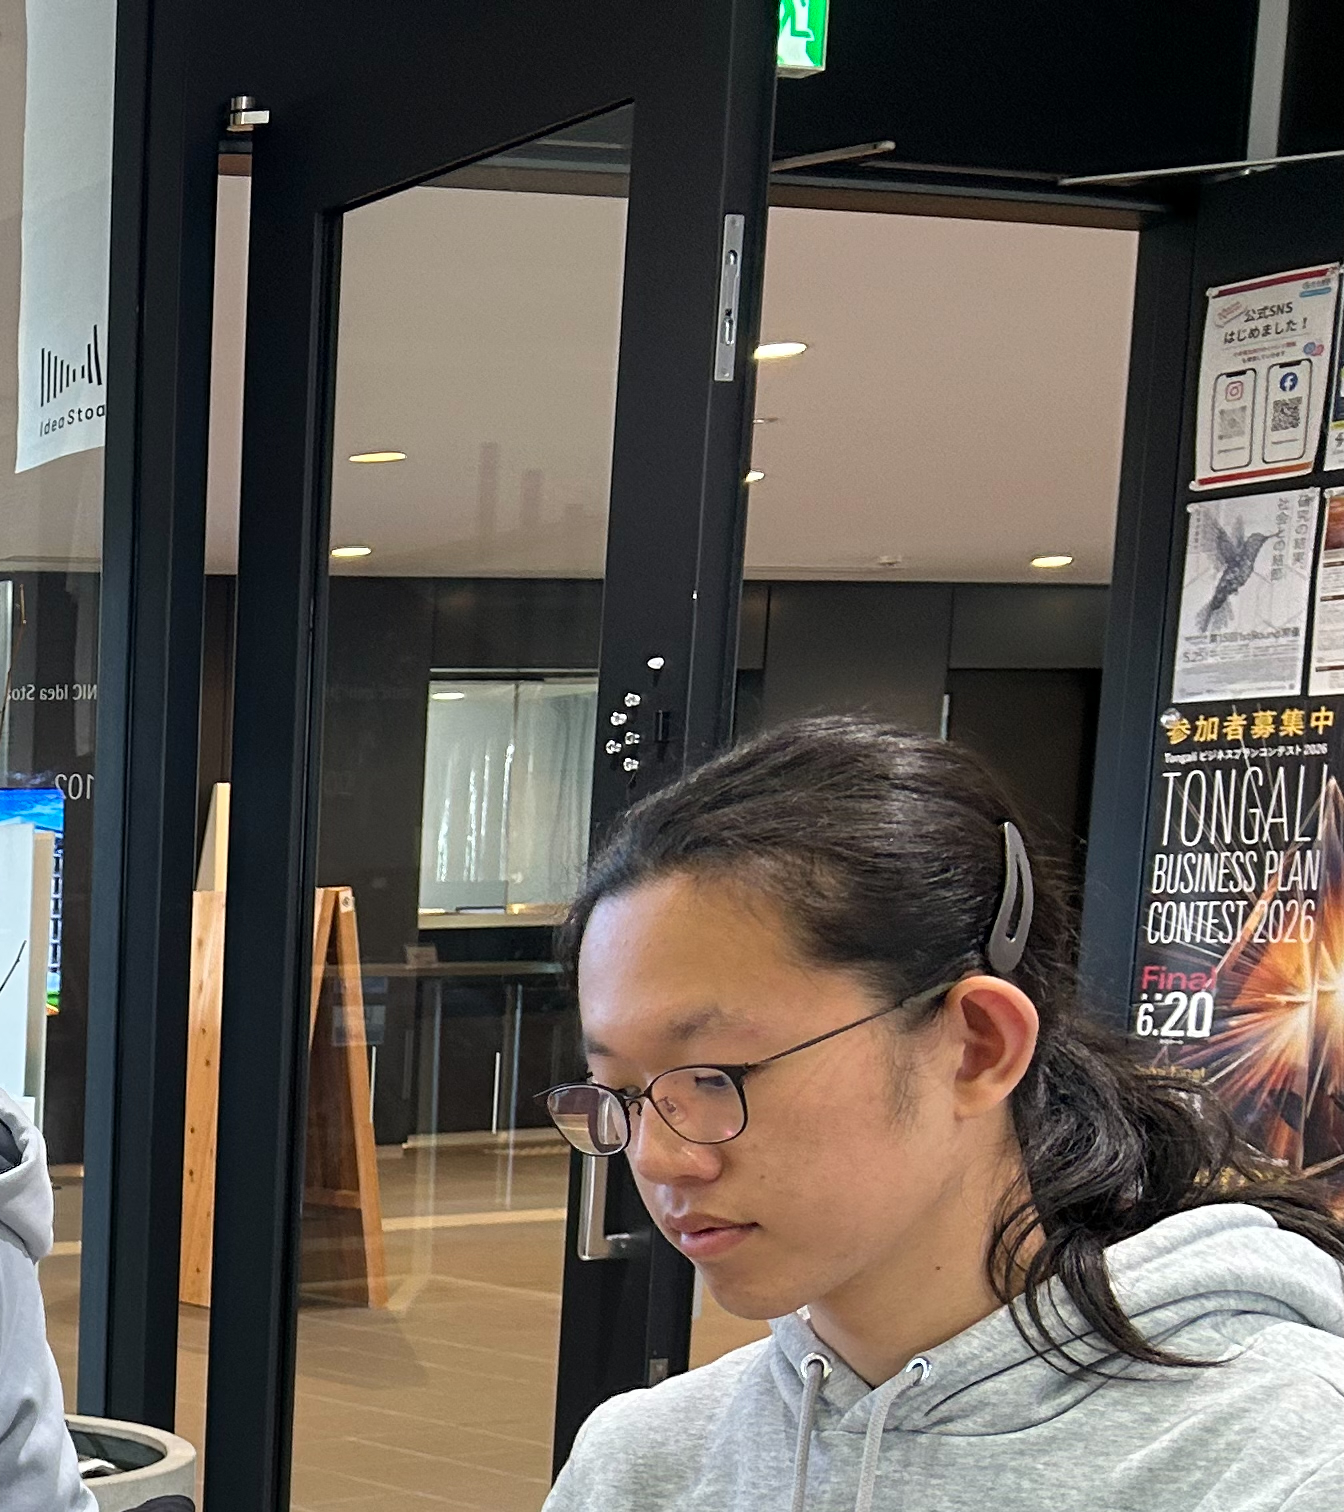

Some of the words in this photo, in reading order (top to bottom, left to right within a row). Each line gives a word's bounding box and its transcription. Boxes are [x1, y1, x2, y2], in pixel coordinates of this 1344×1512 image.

[1166, 705, 1335, 745] 参加者募集中
[1161, 764, 1328, 847] TONGALI
[1151, 850, 1258, 894] BUSINESS
[1264, 849, 1321, 892] PLAN
[1146, 900, 1249, 945] CONTEST
[1253, 899, 1316, 944] 2026
[1141, 964, 1218, 991] Final
[1136, 991, 1214, 1037] 6.20
